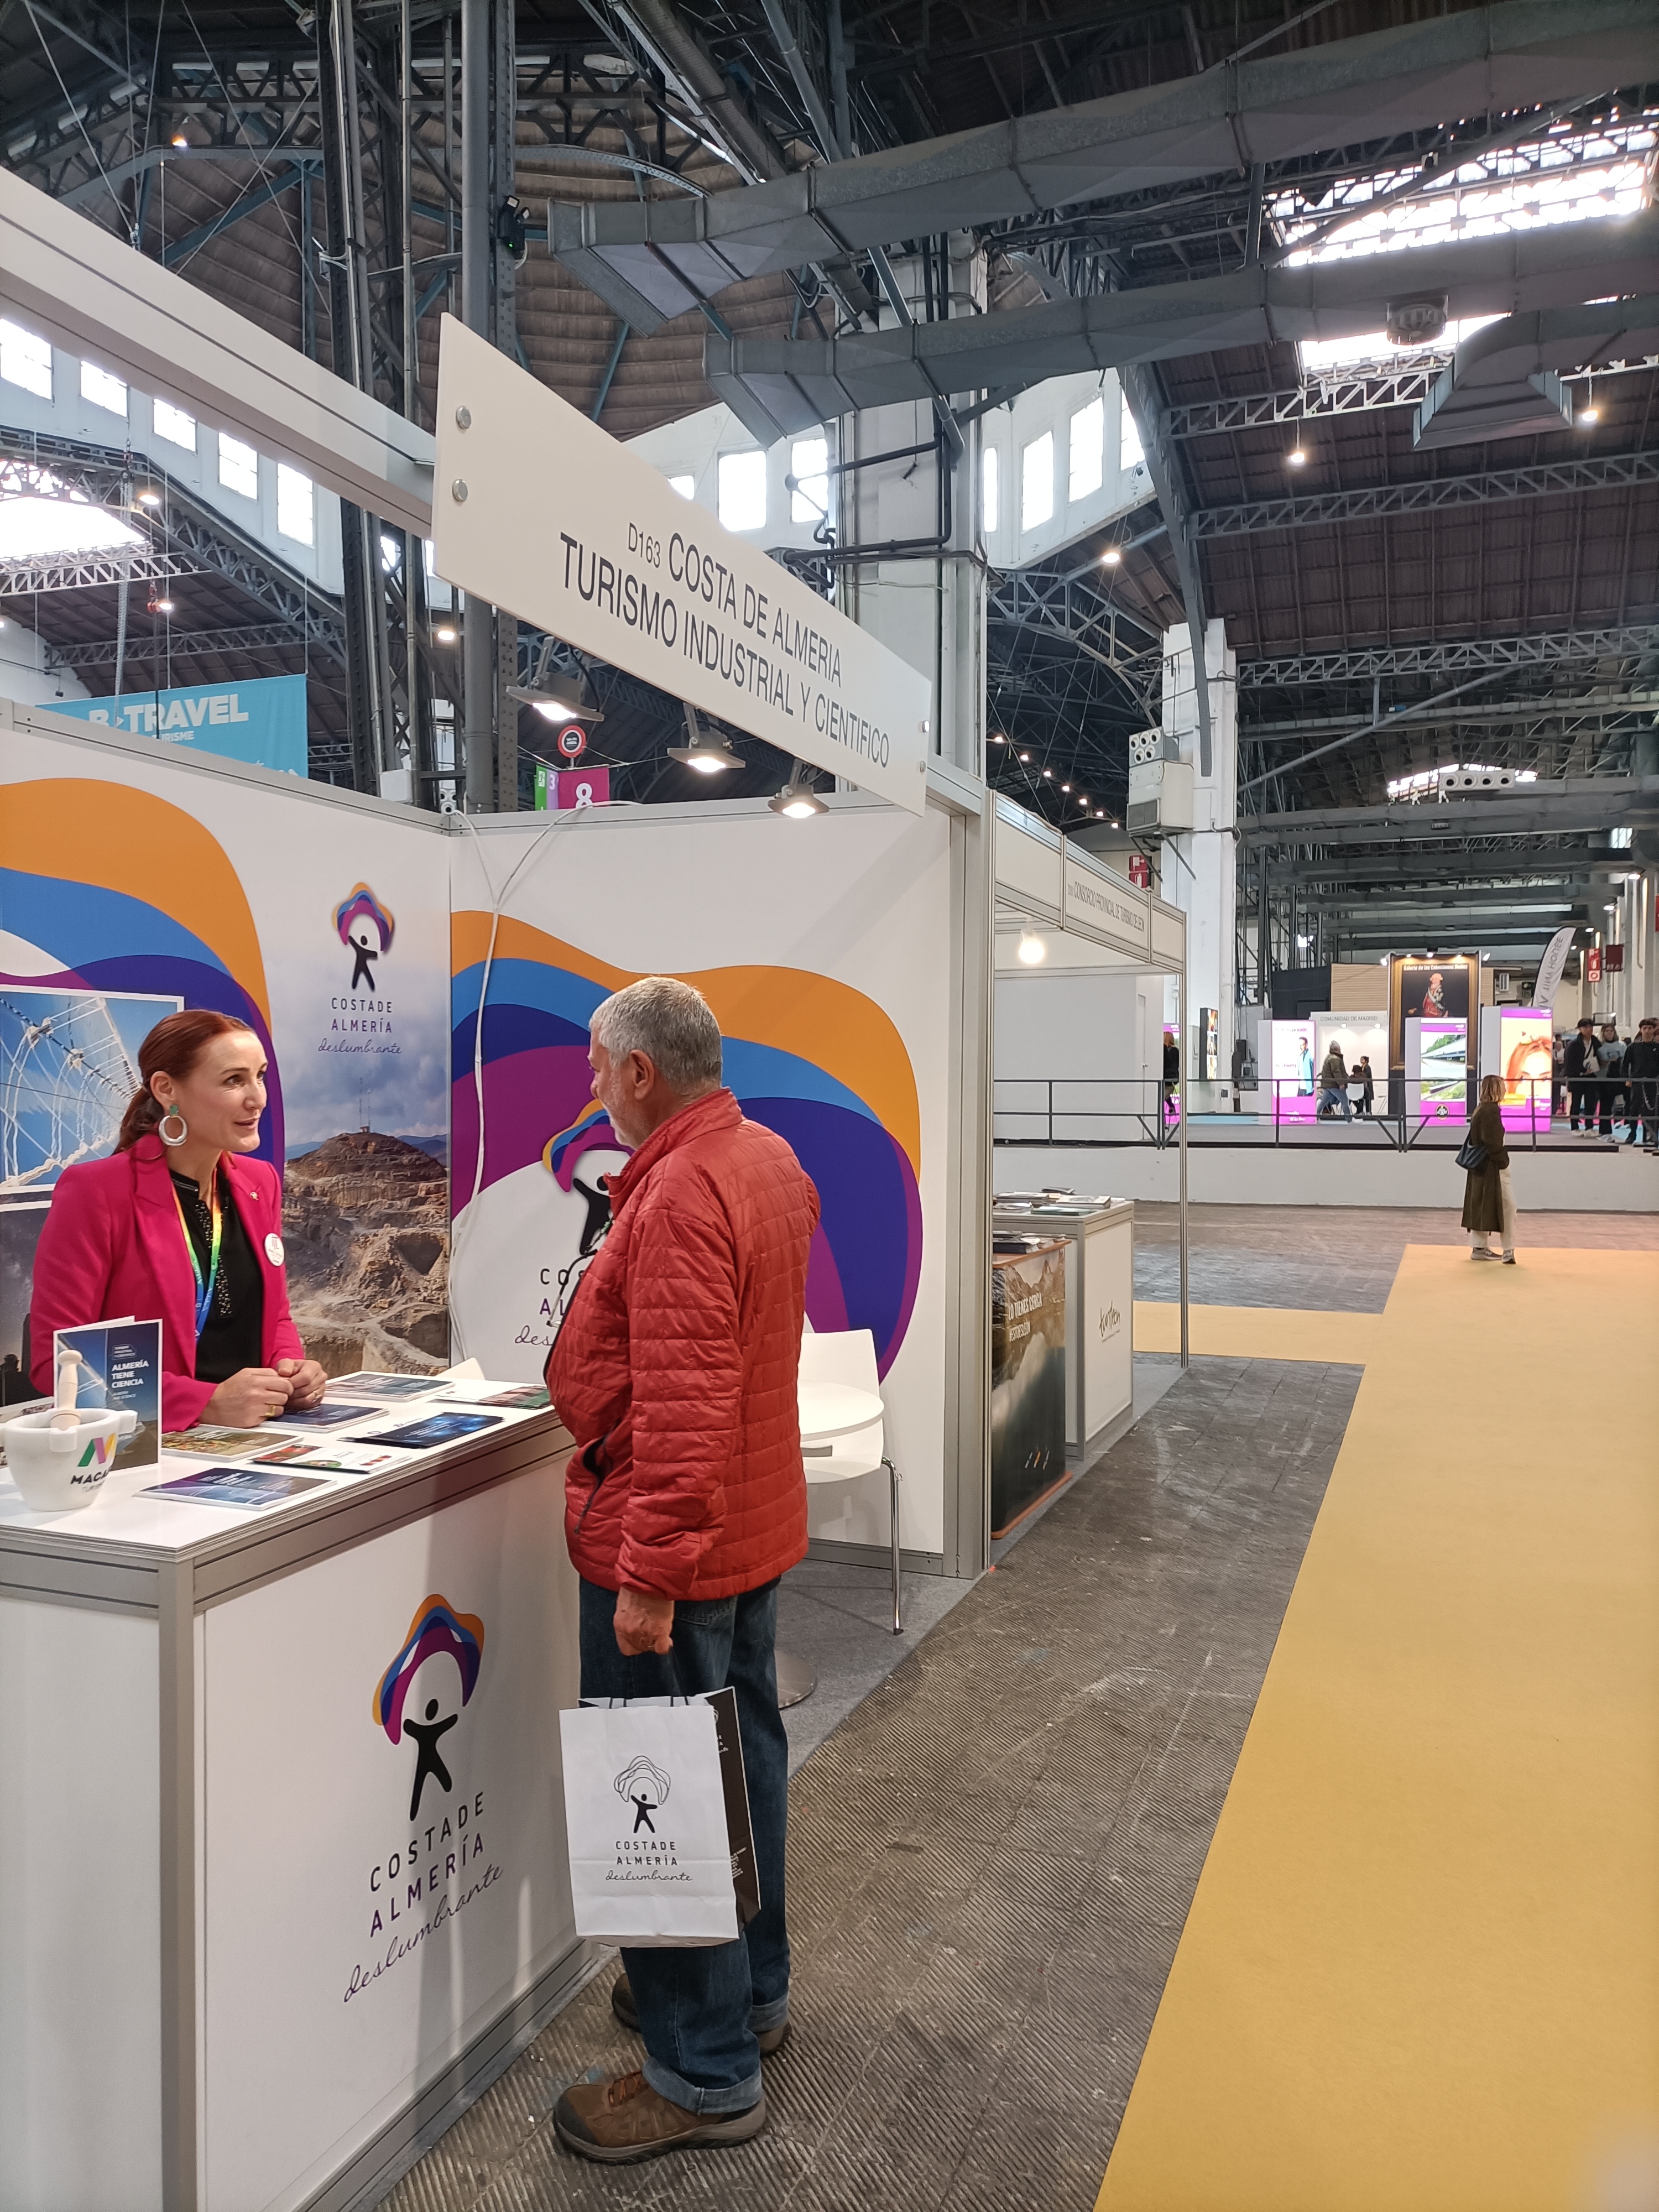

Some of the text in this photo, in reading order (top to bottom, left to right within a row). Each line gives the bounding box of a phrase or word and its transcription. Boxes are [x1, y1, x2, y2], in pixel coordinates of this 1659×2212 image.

[628, 521, 842, 688] D163 COSTA DE ALMERIA
[560, 531, 890, 768] TURISMO INDUSTRIAL Y CIENTIFICO
[549, 774, 556, 790] 3
[575, 782, 593, 809] 8
[331, 1017, 393, 1034] ALMERÍA
[317, 1037, 403, 1054] deslumbrante
[111, 1359, 149, 1372] ALMERÍA
[111, 1370, 135, 1380] TIENE
[111, 1378, 144, 1389] CIENCIA
[616, 1855, 678, 1866] ALMERÍA
[605, 1869, 693, 1882] deslumbrante
[370, 1832, 484, 1938] ALMERÍA
[343, 1863, 504, 2003] deslumbrante
